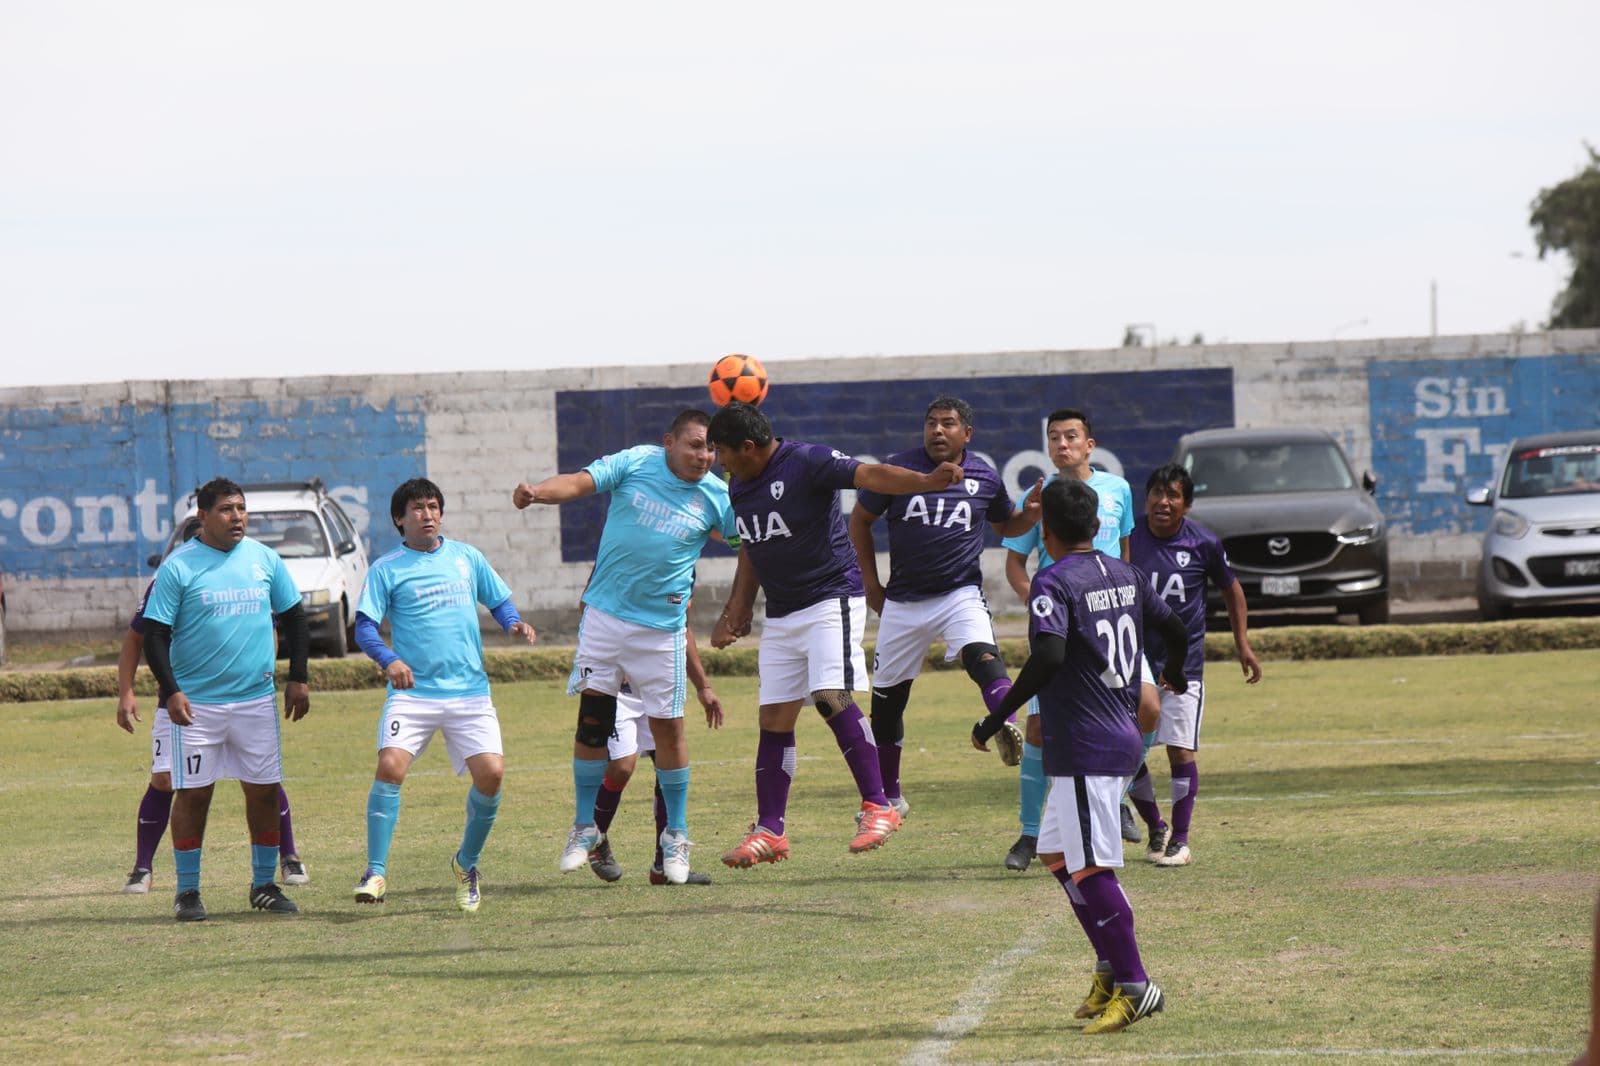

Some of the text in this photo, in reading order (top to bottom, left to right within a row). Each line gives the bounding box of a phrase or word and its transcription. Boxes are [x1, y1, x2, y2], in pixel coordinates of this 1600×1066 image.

[1414, 377, 1511, 419] Sin
[636, 512, 691, 542] FLY BETTER
[735, 511, 793, 544] AIA
[902, 495, 973, 533] AIA
[202, 586, 268, 606] Emirates
[1085, 588, 1112, 613] VIRGEN
[1108, 586, 1120, 609] DE
[1151, 572, 1187, 603] IA
[1095, 613, 1138, 689] 20
[390, 720, 400, 737] 9
[155, 739, 162, 757] 2
[186, 753, 202, 775] 17
